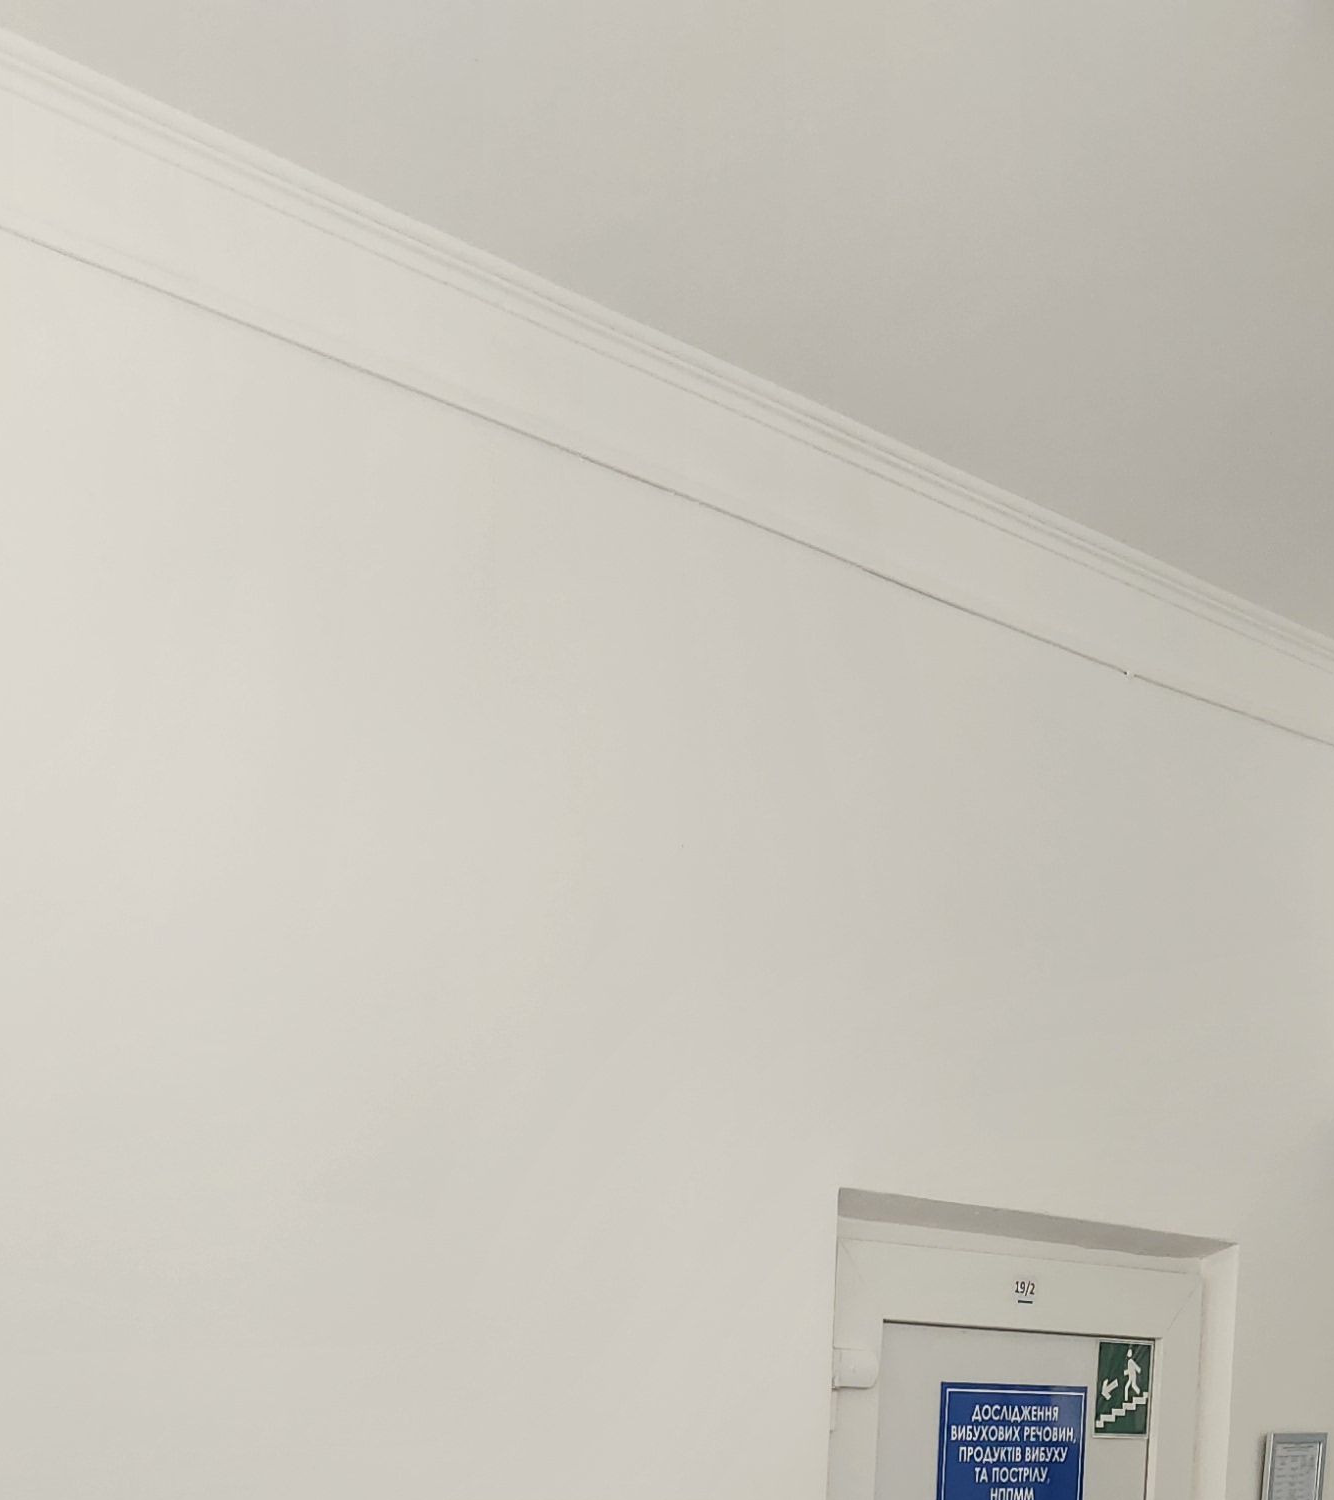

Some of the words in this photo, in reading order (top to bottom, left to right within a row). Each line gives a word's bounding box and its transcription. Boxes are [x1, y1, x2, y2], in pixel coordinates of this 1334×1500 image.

[1014, 1280, 1036, 1297] 19/2
[971, 1404, 1059, 1423] ДОСЛІДЖЕННЯ
[950, 1425, 1021, 1442] ВИБУХОВИХ
[1023, 1426, 1077, 1444] РЕЧОВИН,
[958, 1446, 1022, 1464] ПРОДУКТІВ
[1024, 1447, 1068, 1463] ВИБУХУ
[974, 1467, 989, 1483] ТА
